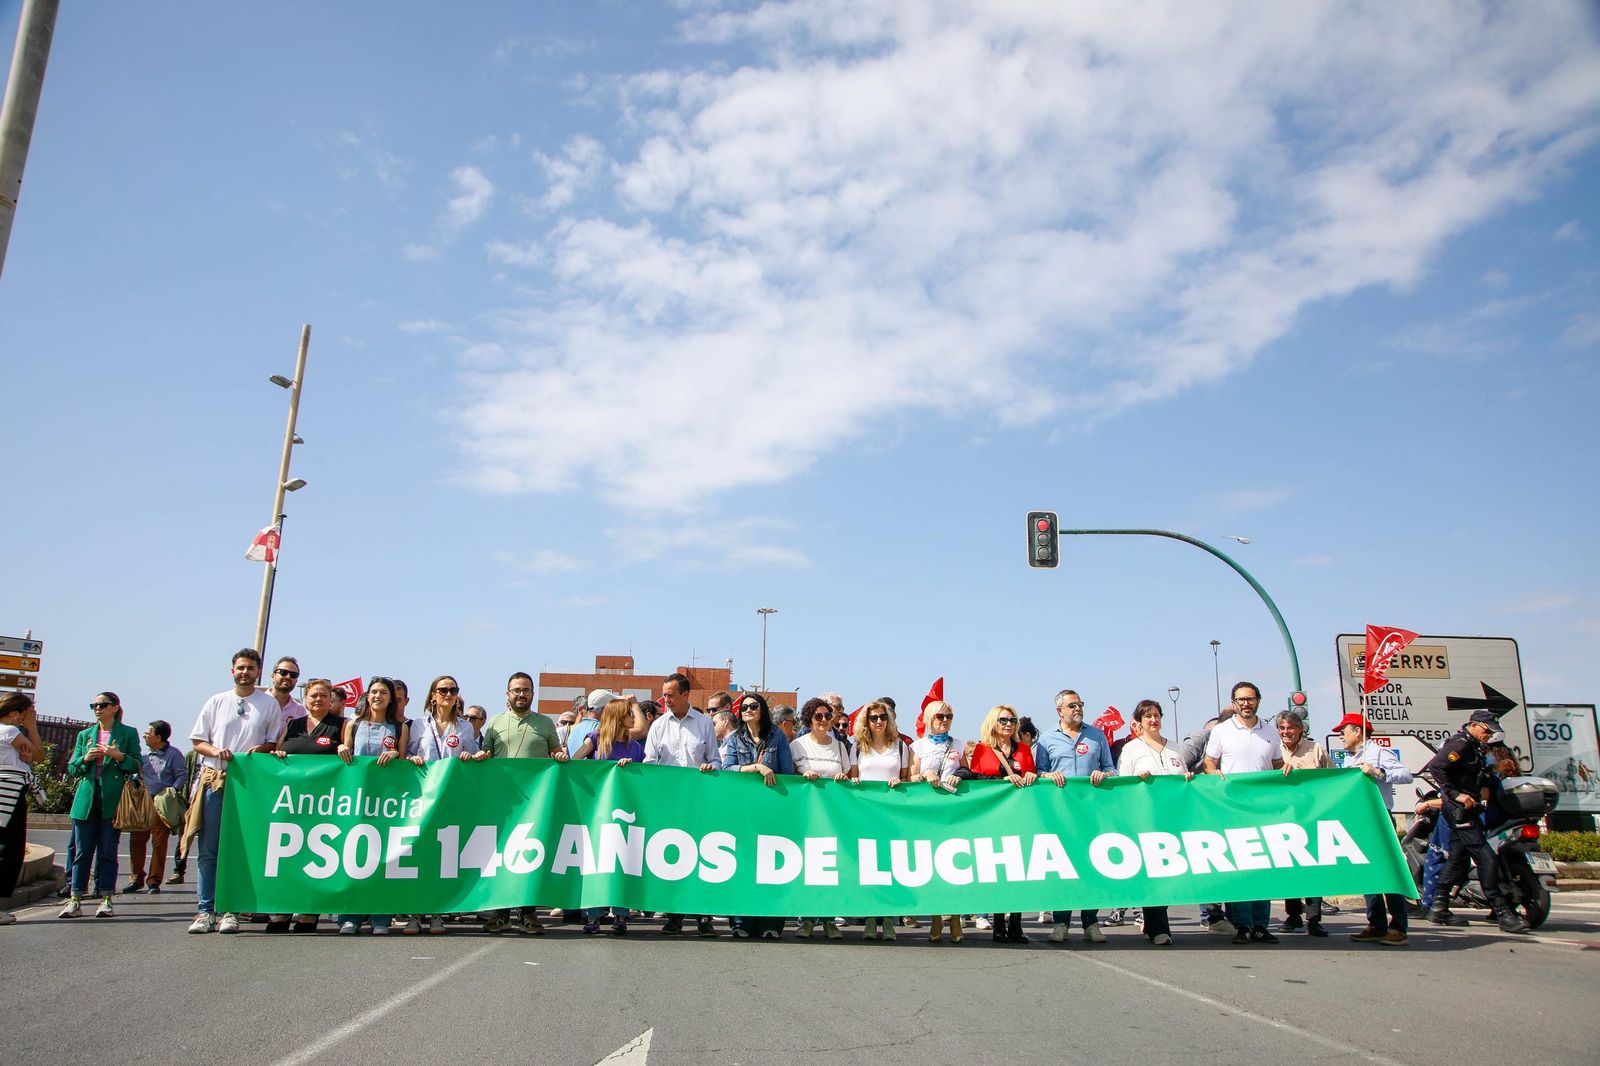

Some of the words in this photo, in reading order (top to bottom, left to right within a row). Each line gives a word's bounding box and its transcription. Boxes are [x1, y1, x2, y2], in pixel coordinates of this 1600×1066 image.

[1390, 655, 1447, 669] ERRYS
[1358, 683, 1403, 694] NDOR
[1359, 695, 1413, 706] MELILLA
[1533, 723, 1573, 741] 630
[271, 785, 424, 819] Andalucía
[264, 822, 420, 881] PSOE
[436, 821, 546, 880] 146
[551, 808, 738, 884] AÑOS
[755, 834, 839, 887] DE
[858, 833, 1080, 888] LUCHA
[1088, 819, 1370, 880] OBRERA
